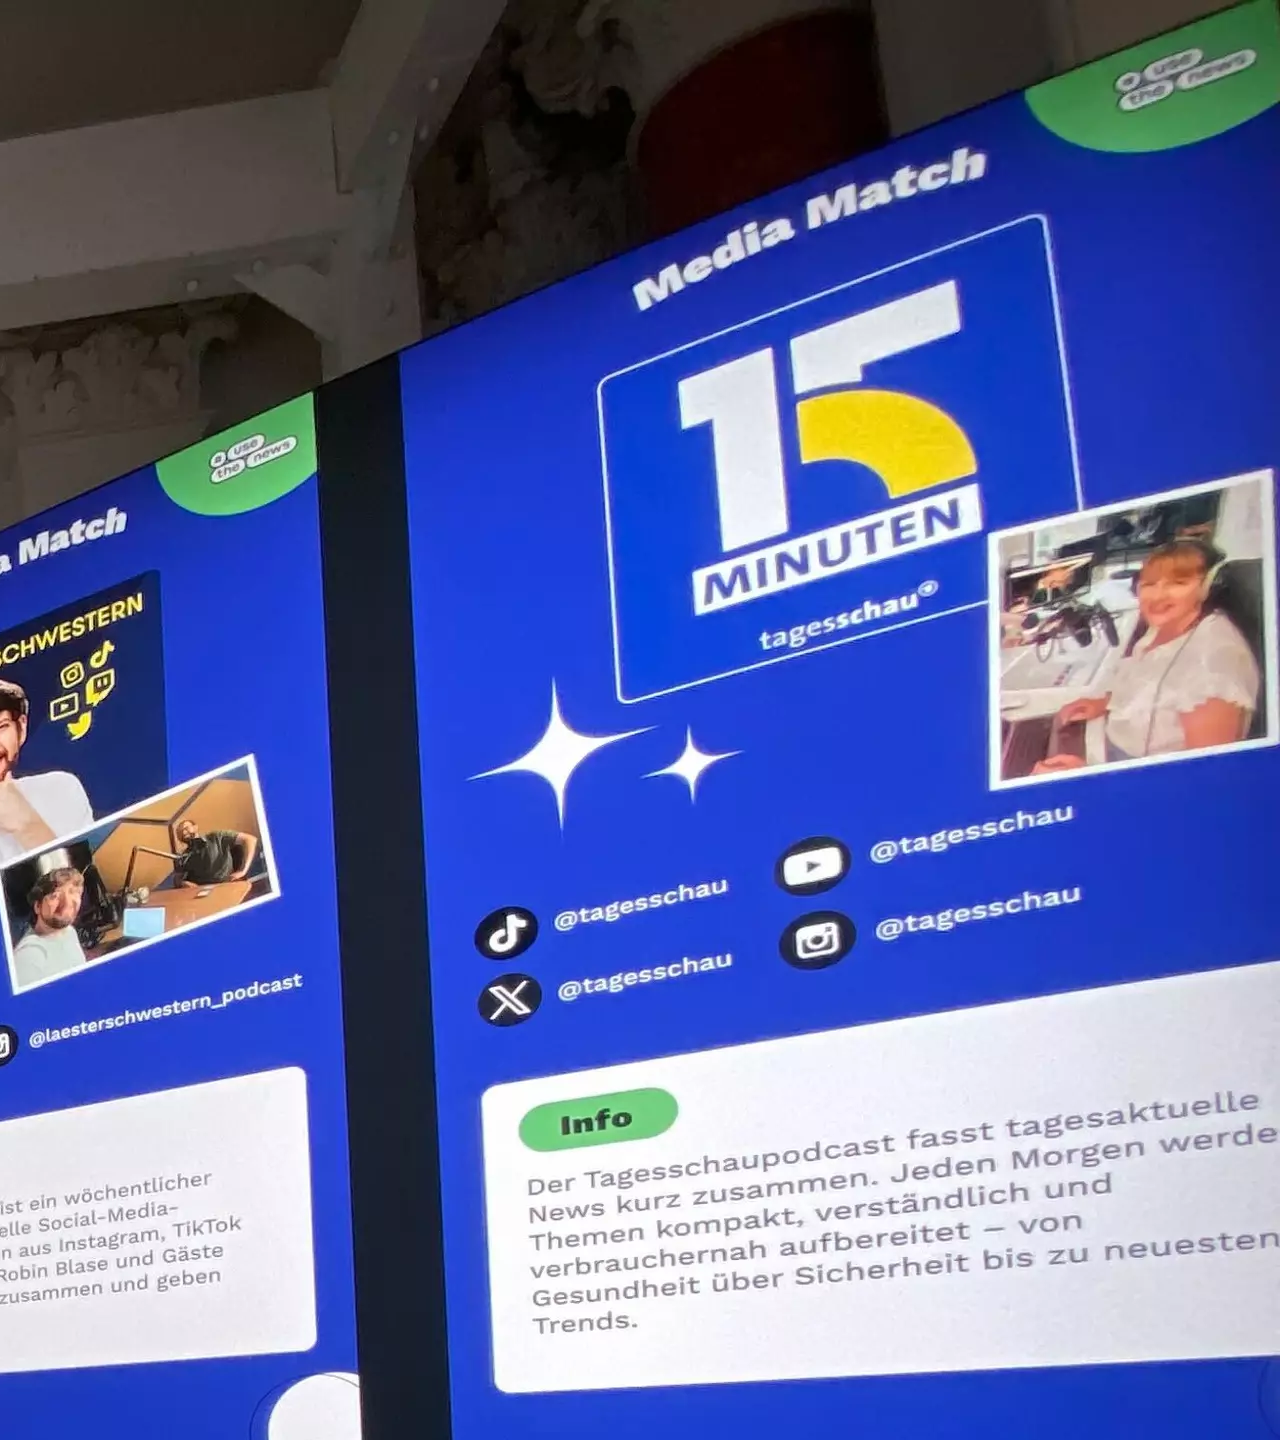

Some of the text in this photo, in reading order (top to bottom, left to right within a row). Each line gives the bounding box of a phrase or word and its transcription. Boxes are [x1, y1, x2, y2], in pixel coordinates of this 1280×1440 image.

[631, 146, 988, 312] Media Match
[678, 280, 980, 554] 15
[216, 441, 290, 478] the news
[233, 438, 259, 456] use
[17, 507, 128, 566] Match
[702, 501, 963, 609] MINUTEN
[759, 590, 920, 652] tagesschau
[869, 804, 1075, 865] @tagesschau
[553, 876, 730, 933] @tagesschau
[874, 884, 1083, 943] @tagesschau
[556, 951, 735, 1003] @tagesschau
[29, 972, 303, 1050] @laesterschwestern_podcast
[527, 1089, 1263, 1197] Der Tagesschaupodcast fasst tagesaktuelle
[559, 1105, 634, 1137] Info
[0, 1199, 24, 1217] ist
[29, 1193, 57, 1212] ein
[63, 1171, 213, 1206] wöchentlicher
[528, 1170, 1113, 1252] Themen kompakt, verständlich und
[529, 1201, 605, 1225] News
[616, 1193, 681, 1214] kurz
[692, 1171, 879, 1206] zusammen.
[890, 1155, 997, 1184] Jeden
[1011, 1139, 1146, 1171] Morgen
[18, 1242, 52, 1259] aus
[59, 1228, 166, 1253] Instagram,
[171, 1214, 242, 1239] TikTok
[38, 1200, 179, 1234] Social-Media-
[529, 1238, 767, 1280] verbrauchernah
[779, 1221, 971, 1258] aufbereitet
[1017, 1213, 1083, 1236] von
[55, 1258, 109, 1278] Blase
[115, 1248, 154, 1270] und
[162, 1243, 224, 1265] Gäste
[110, 1272, 149, 1295] und
[156, 1268, 221, 1294] geben
[532, 1276, 701, 1308] Gesundheit
[712, 1270, 785, 1294] über
[795, 1252, 970, 1287] Sicherheit
[982, 1247, 1034, 1271] bis
[1047, 1246, 1089, 1267] zu
[531, 1309, 638, 1335] Trends.
